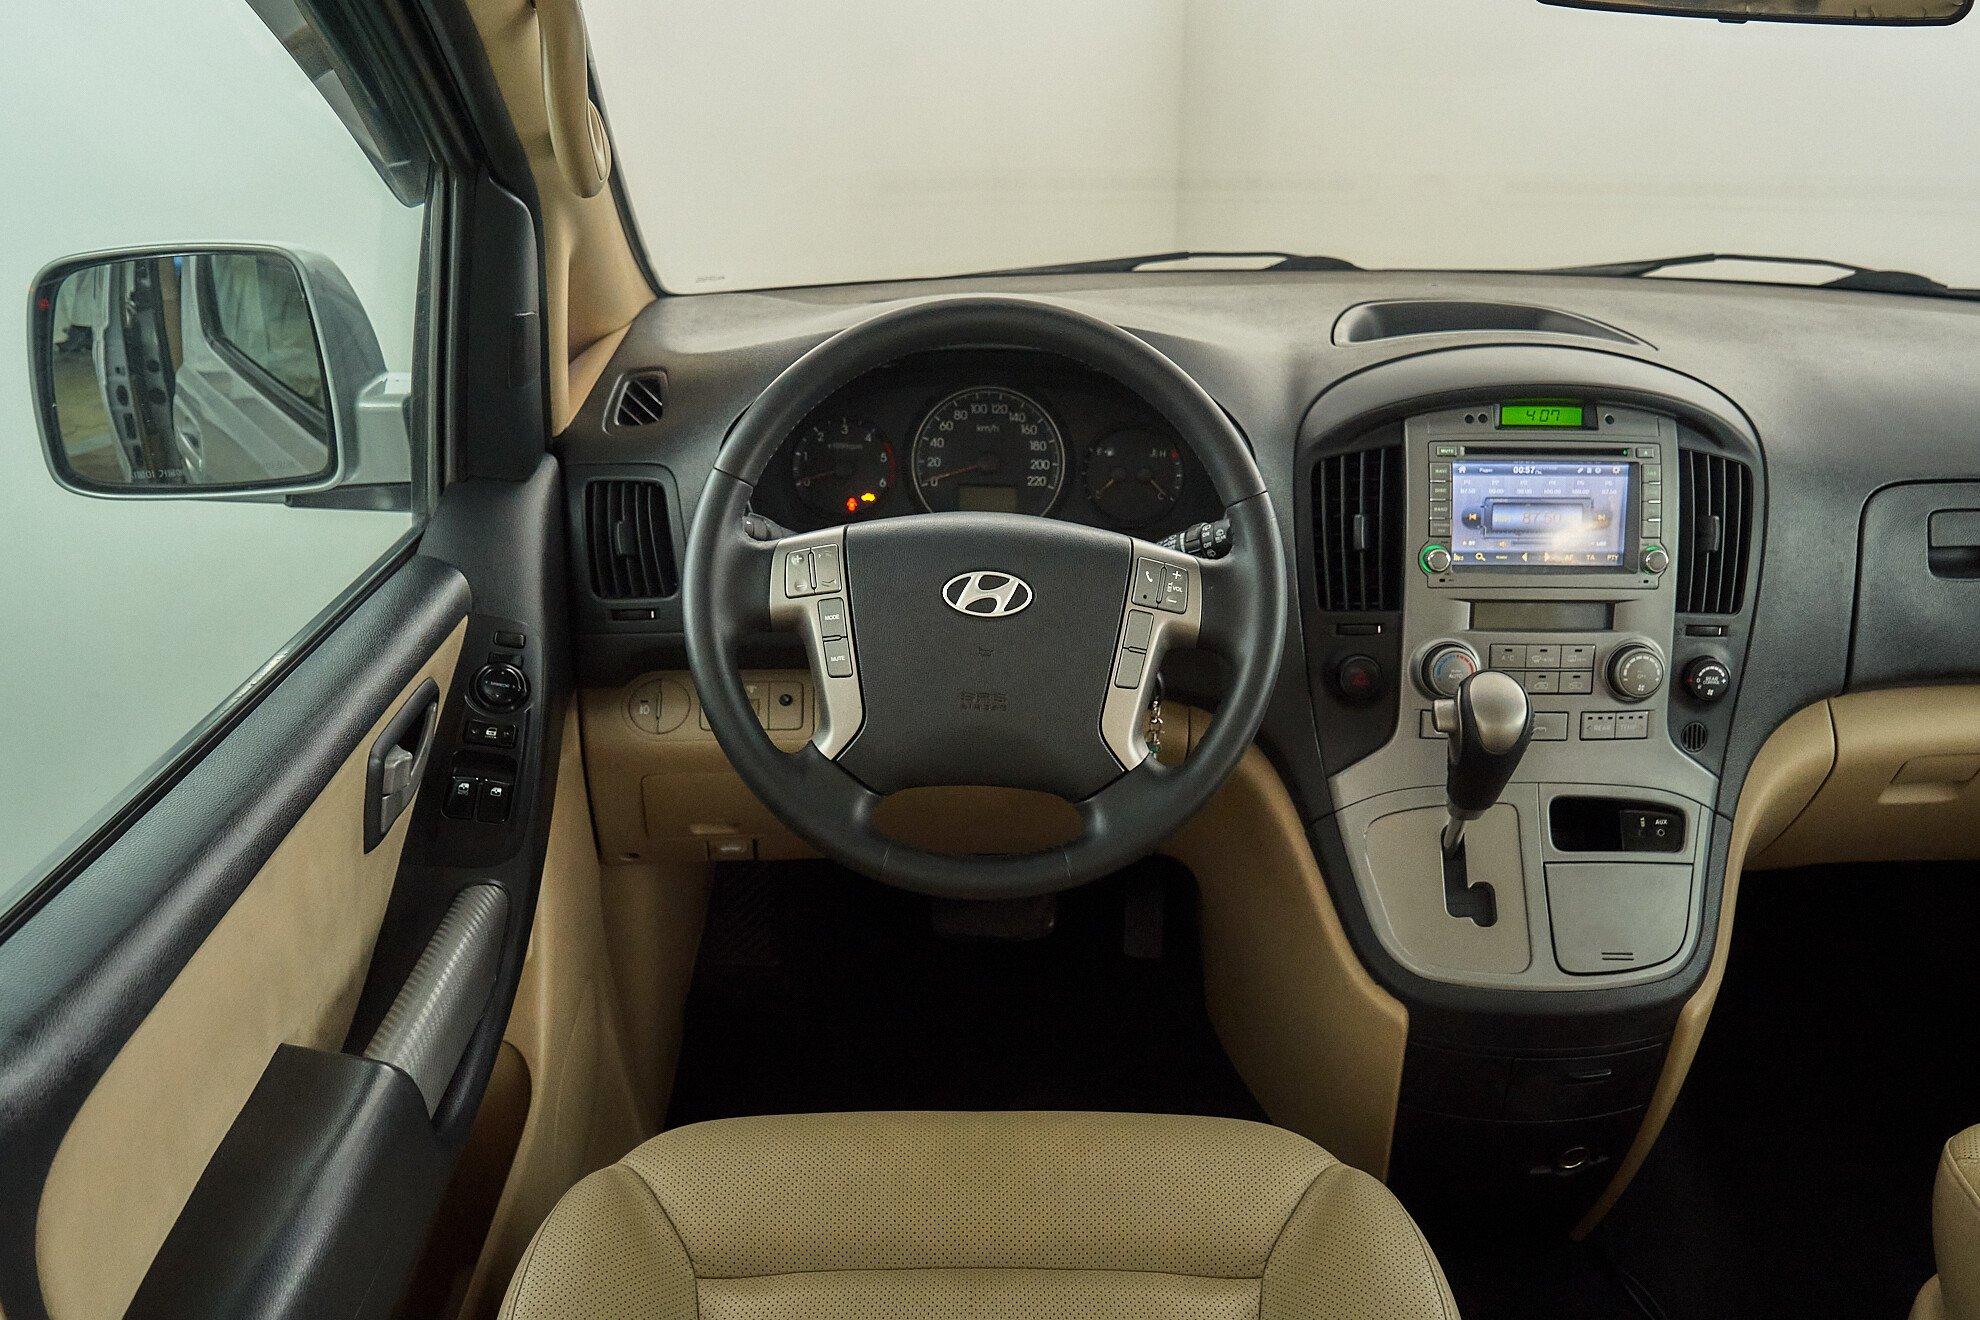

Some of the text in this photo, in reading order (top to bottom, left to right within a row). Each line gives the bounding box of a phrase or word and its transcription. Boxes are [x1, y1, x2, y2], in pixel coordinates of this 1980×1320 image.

[970, 404, 988, 414] 100
[991, 404, 1008, 414] 120
[953, 410, 968, 420] 80
[1008, 412, 1026, 423] 140
[841, 424, 848, 434] 3
[939, 420, 954, 431] 60
[1020, 424, 1038, 435] 160
[817, 432, 824, 442] 2
[864, 433, 872, 442] 4
[930, 438, 945, 448] 40
[1030, 440, 1047, 451] 180
[927, 457, 941, 468] 20
[1030, 460, 1050, 470] 200
[1513, 466, 1536, 474] 00:57
[879, 478, 887, 488] 6
[1026, 476, 1047, 486] 220
